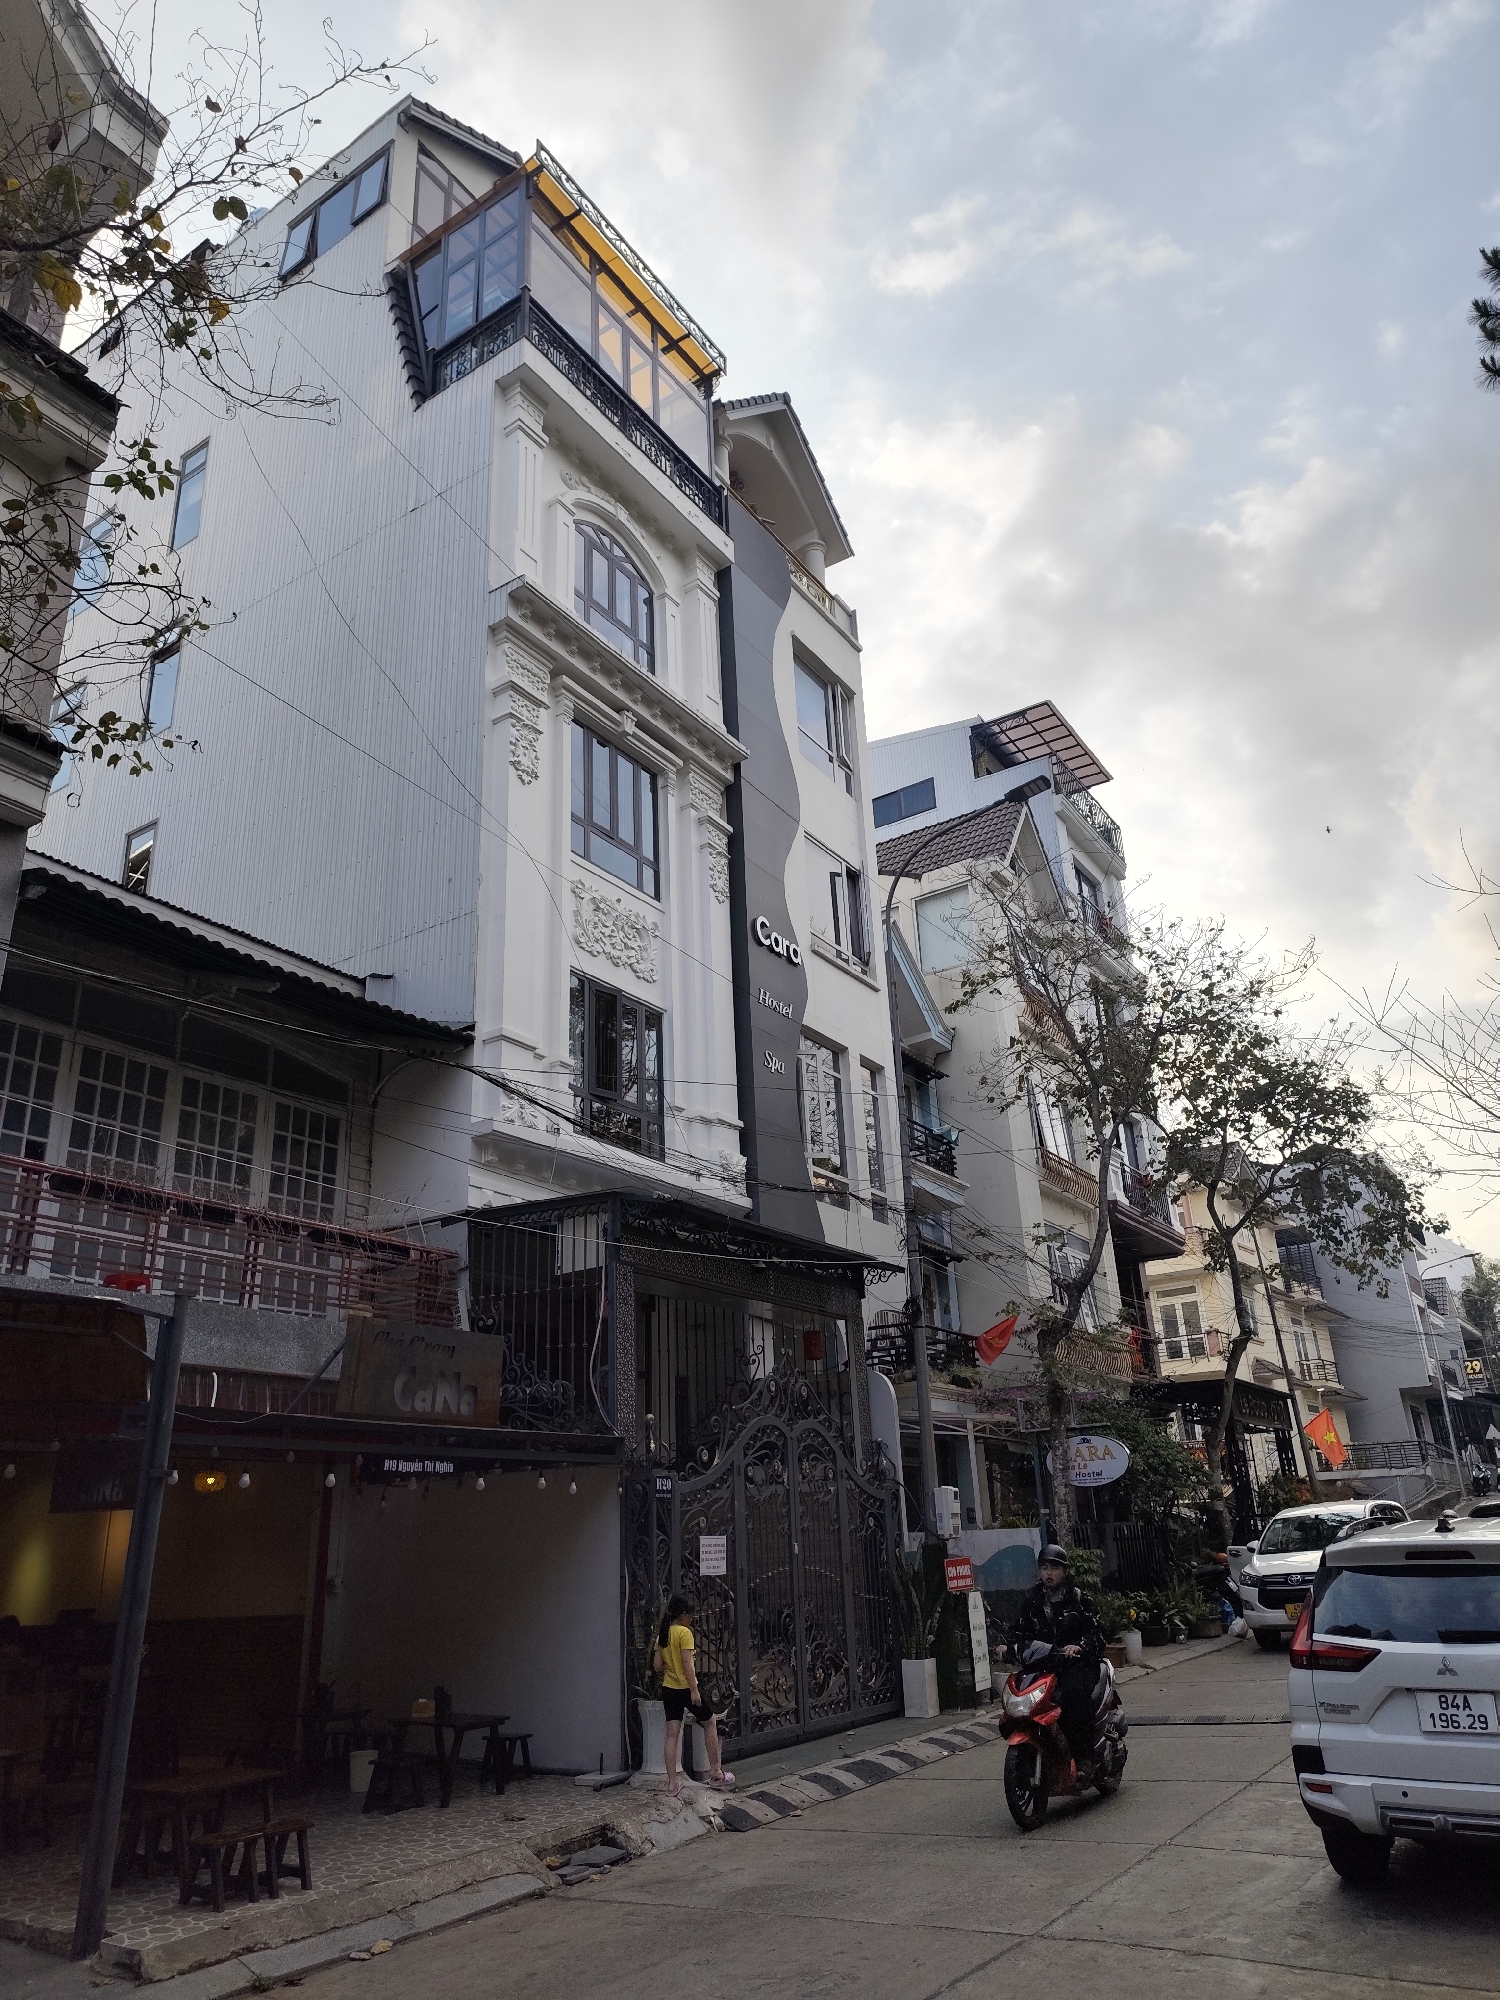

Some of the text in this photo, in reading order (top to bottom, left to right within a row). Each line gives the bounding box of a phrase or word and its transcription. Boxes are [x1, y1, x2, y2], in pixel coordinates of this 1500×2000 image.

[754, 915, 803, 965] Cara
[758, 987, 793, 1019] Hostel
[764, 1050, 786, 1075] Spa
[1464, 1360, 1481, 1373] 29
[393, 1365, 478, 1416] CaNa
[383, 1459, 397, 1472] H19
[1075, 1469, 1103, 1478] Hostel
[656, 1478, 672, 1491] H20
[1438, 1694, 1472, 1711] 84A
[1430, 1712, 1489, 1731] 196.29
